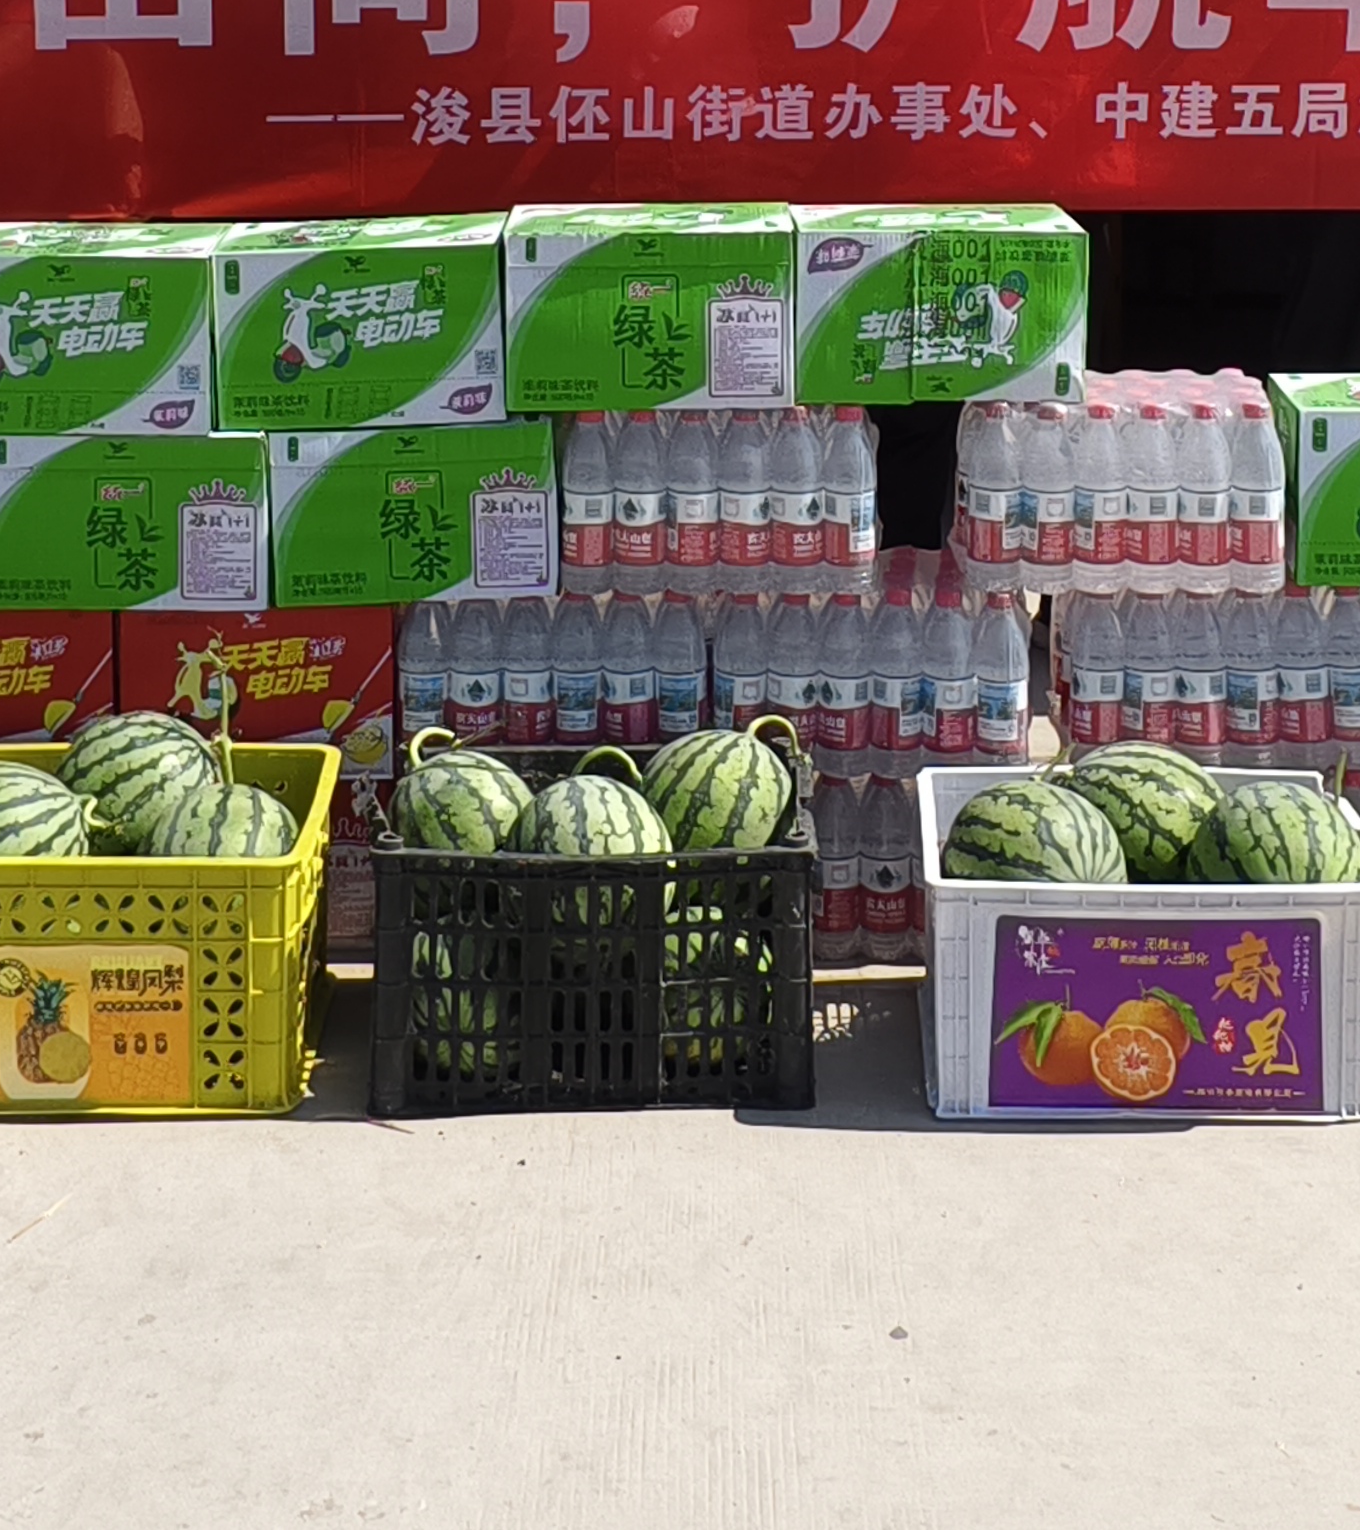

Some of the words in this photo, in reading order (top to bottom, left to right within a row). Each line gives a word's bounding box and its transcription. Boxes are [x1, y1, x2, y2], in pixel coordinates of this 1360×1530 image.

[57, 321, 148, 358] 电动车
[354, 309, 443, 348] 电动车
[246, 665, 332, 700] 电动车
